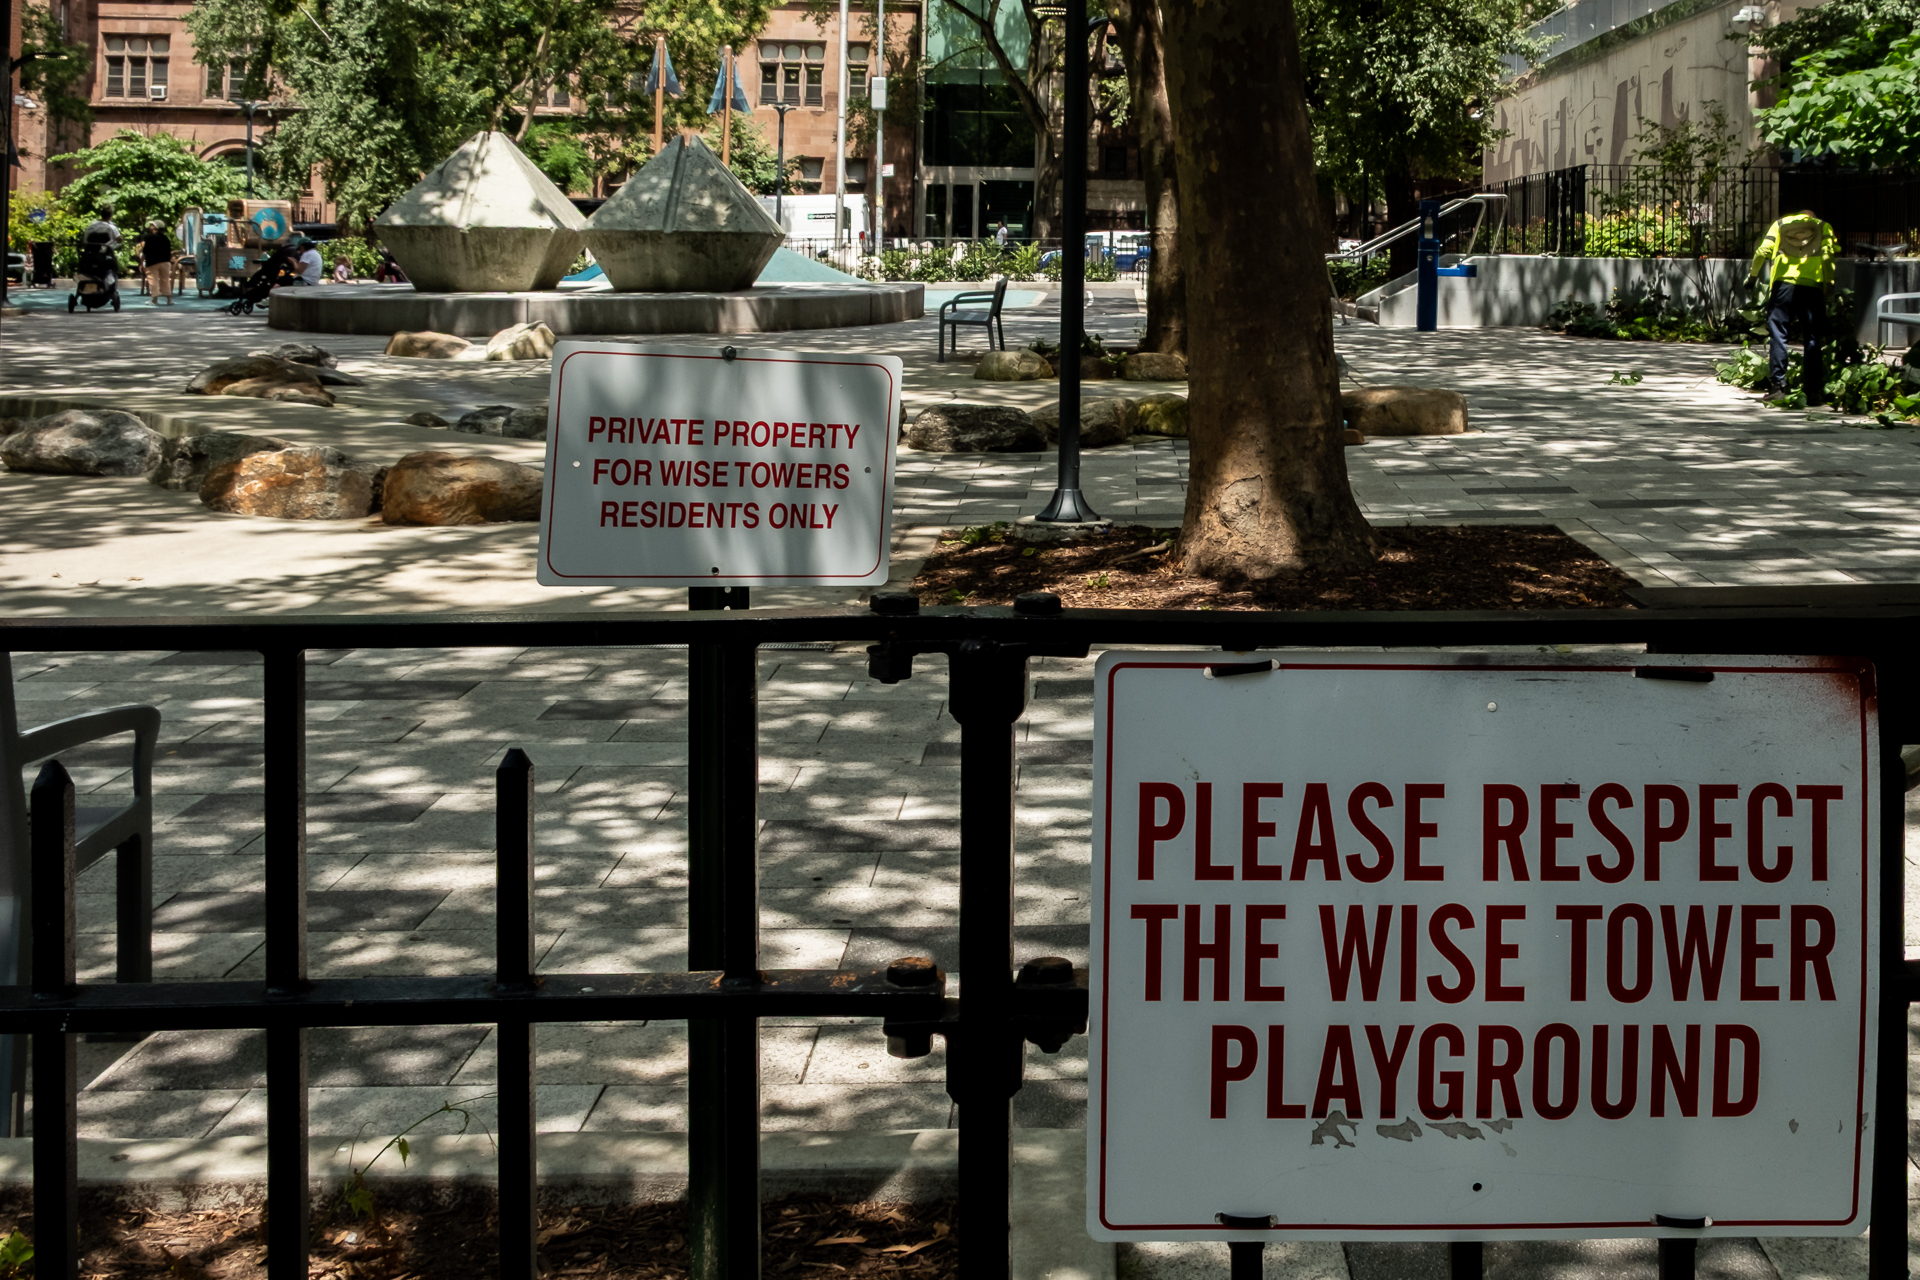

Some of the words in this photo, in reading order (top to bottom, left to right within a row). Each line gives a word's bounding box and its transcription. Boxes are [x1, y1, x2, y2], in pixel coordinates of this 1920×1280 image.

[588, 416, 704, 446] PRIVATE
[713, 420, 860, 449] PROPERTY
[592, 458, 653, 486] FOR
[659, 460, 729, 487] WISE
[735, 462, 850, 490] TOWERS
[600, 501, 760, 529] RESIDENTS
[768, 503, 839, 530] ONLY
[1137, 781, 1445, 884] PLEASE
[1482, 782, 1844, 884] RESPECT
[1130, 903, 1287, 1002] THE
[1318, 903, 1526, 1003] WISE
[1555, 903, 1837, 1004] TOWER
[1210, 1022, 1761, 1121] PLAYGROUND
